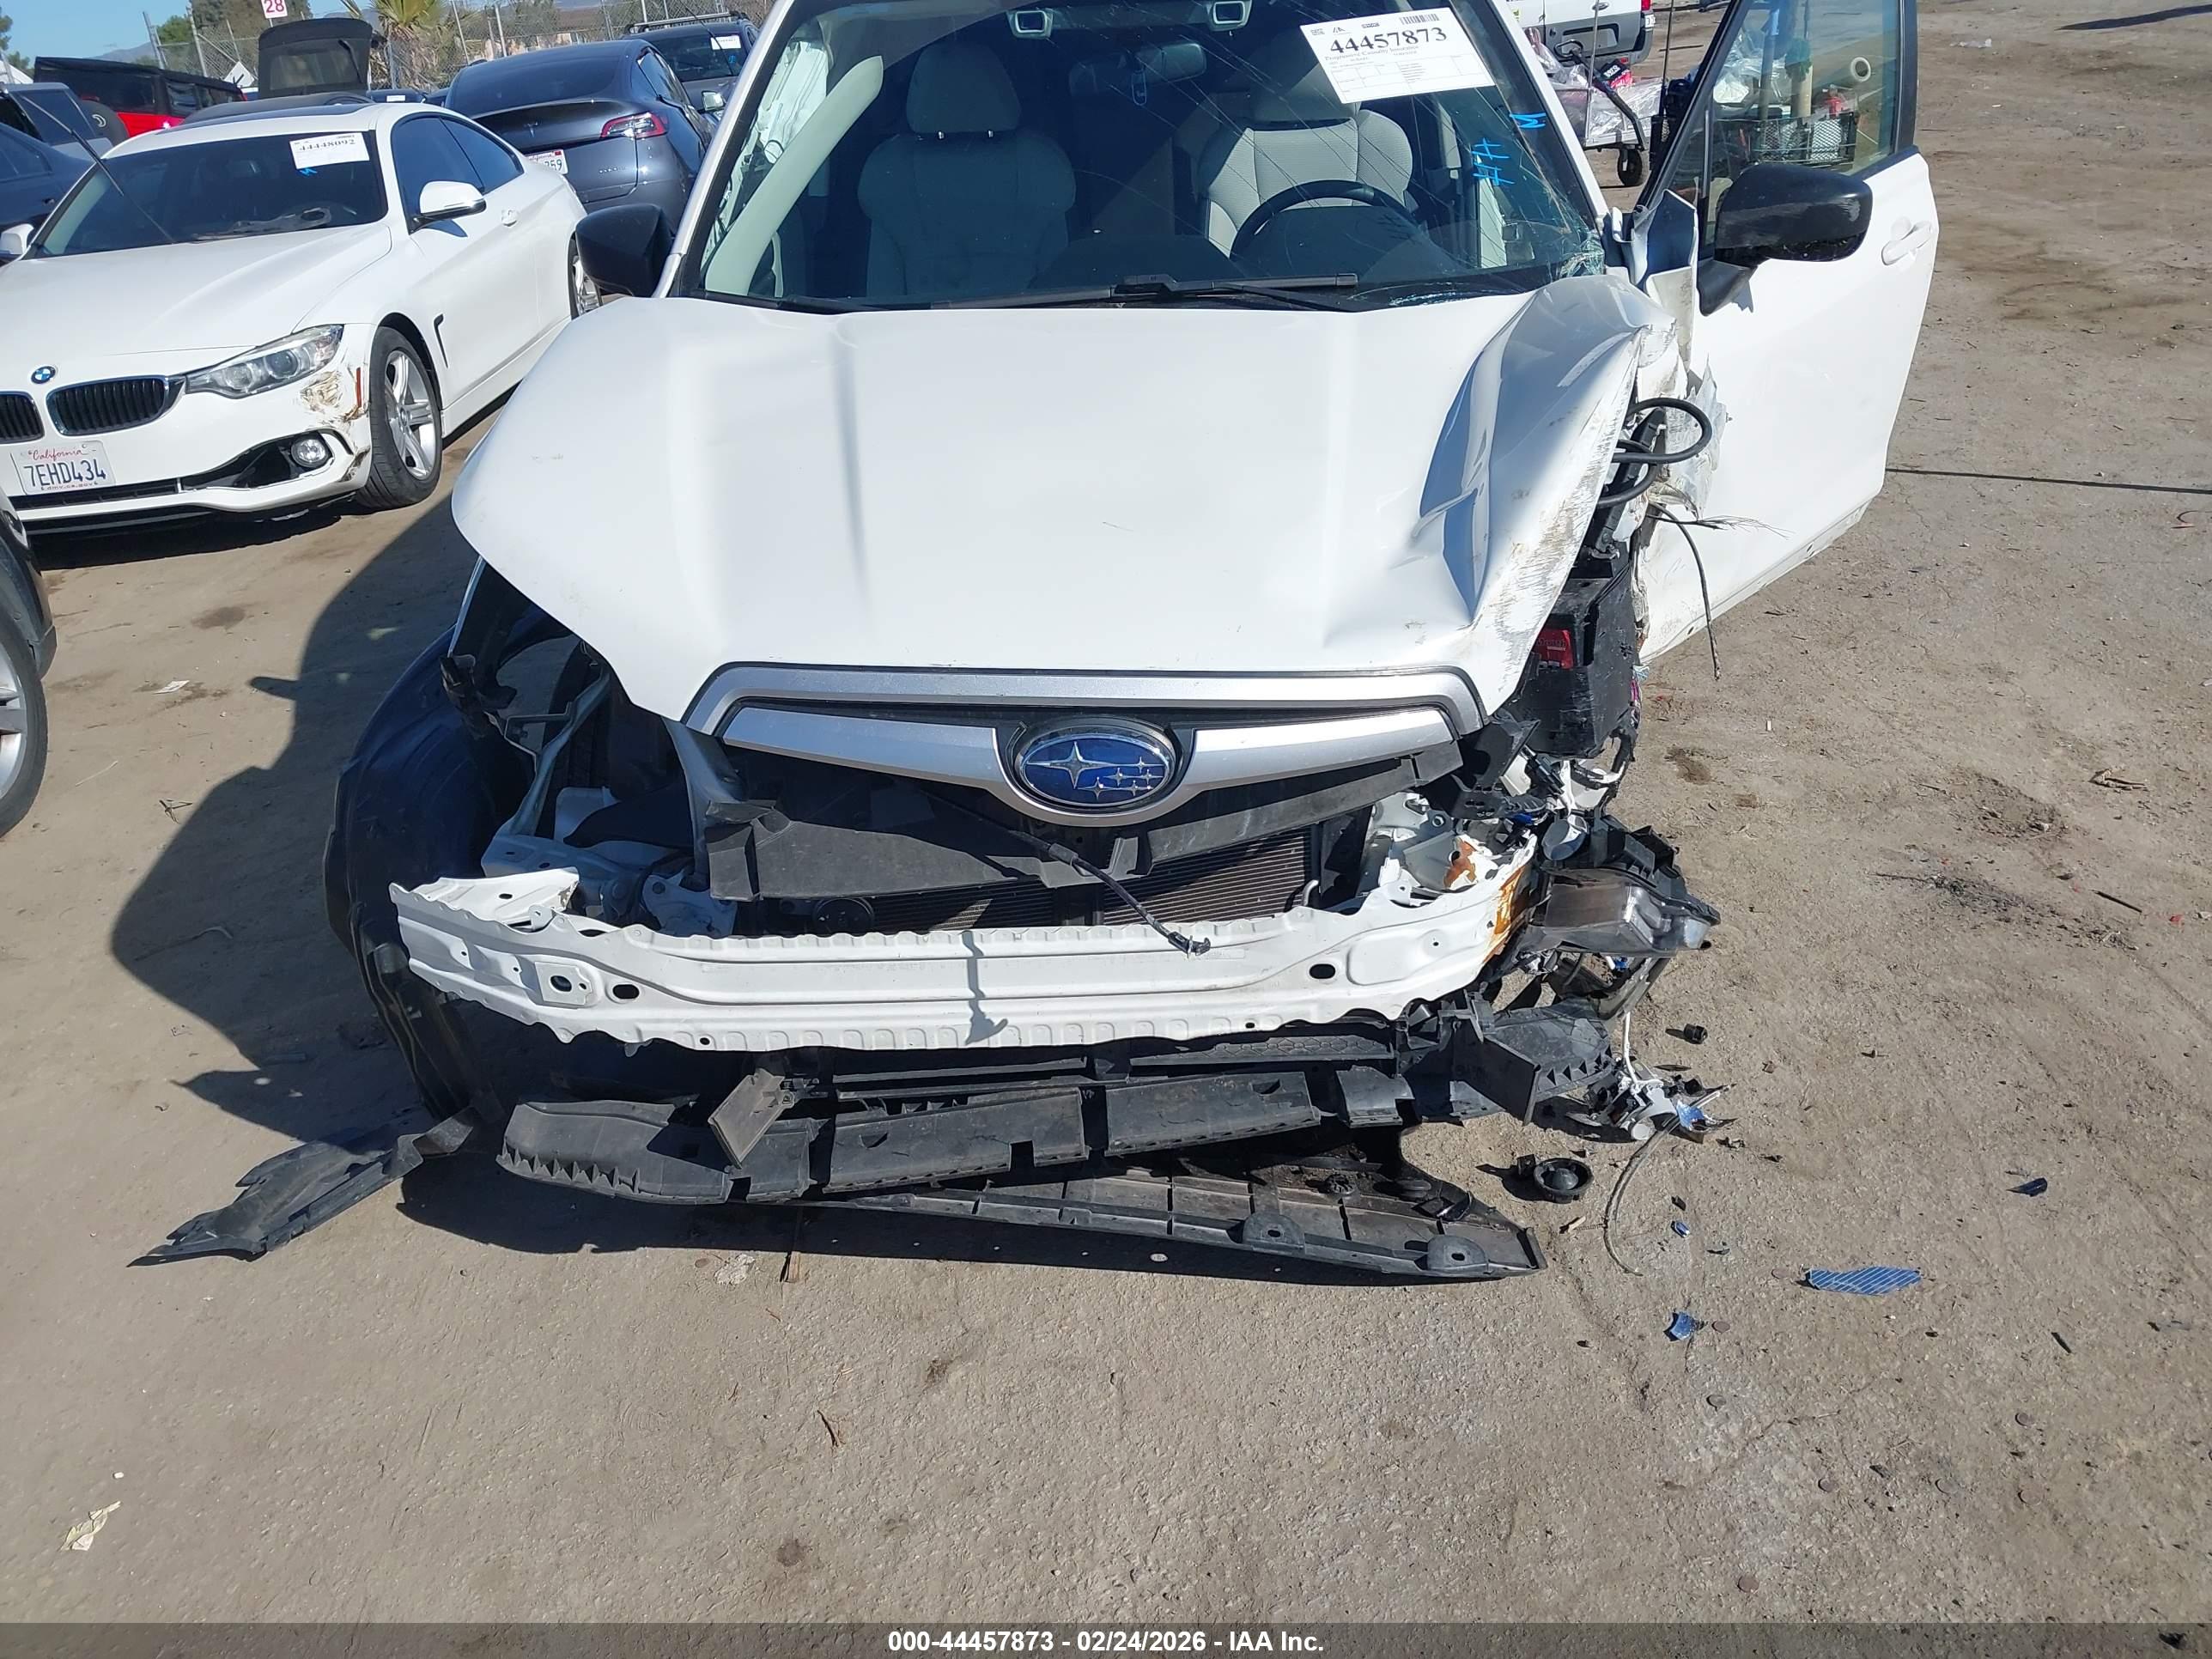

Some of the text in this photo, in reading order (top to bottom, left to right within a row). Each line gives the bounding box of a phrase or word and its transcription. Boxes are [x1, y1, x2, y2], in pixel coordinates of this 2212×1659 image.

[265, 0, 284, 13] 28
[1330, 27, 1447, 53] 44457873
[33, 447, 83, 461] California
[23, 459, 106, 487] 7EHD434
